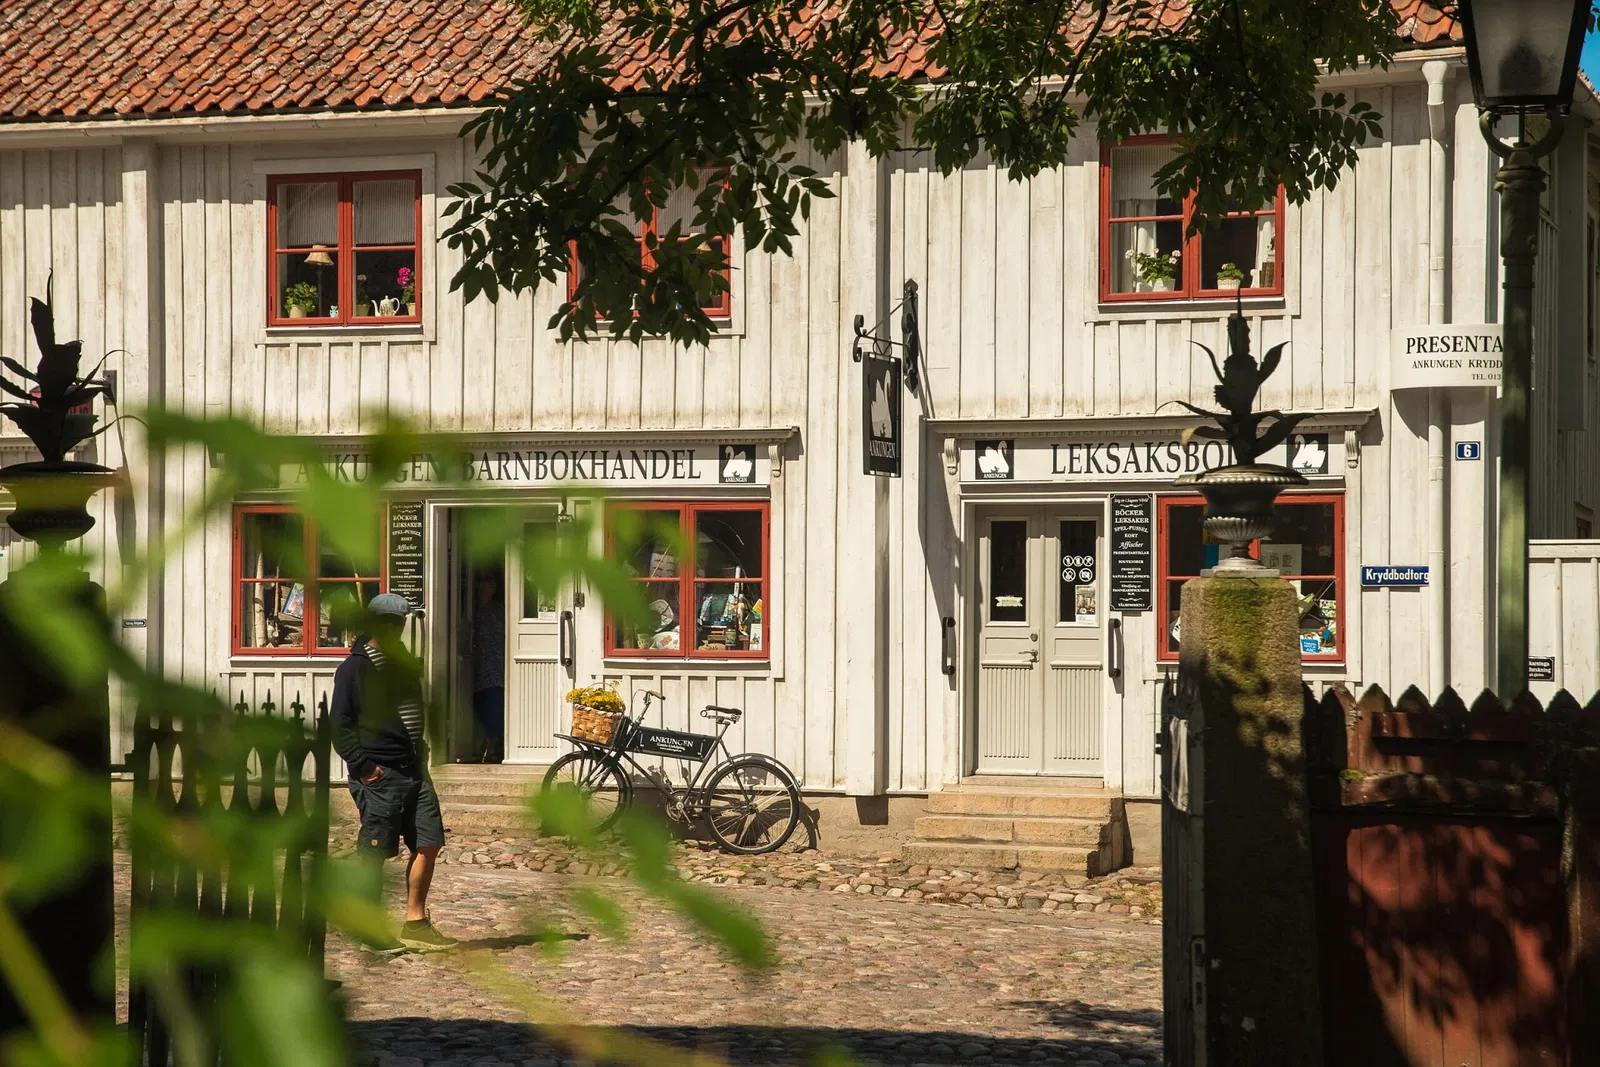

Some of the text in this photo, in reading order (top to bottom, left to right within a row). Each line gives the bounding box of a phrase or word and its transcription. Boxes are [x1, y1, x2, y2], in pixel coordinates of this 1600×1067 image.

[1406, 335, 1503, 354] PRESENTA
[1412, 359, 1503, 369] ANKUNGEN KRYDD
[869, 440, 896, 458] ANKUNGEN
[1464, 444, 1472, 458] 6
[294, 449, 701, 483] ANKUGEN BARNBOKHANDEL
[1114, 525, 1149, 533] SPEL-PUSSEL
[1119, 541, 1144, 549] Affischer
[1366, 568, 1429, 583] Kryddbodtorg
[650, 735, 694, 747] ANKUNGEN
